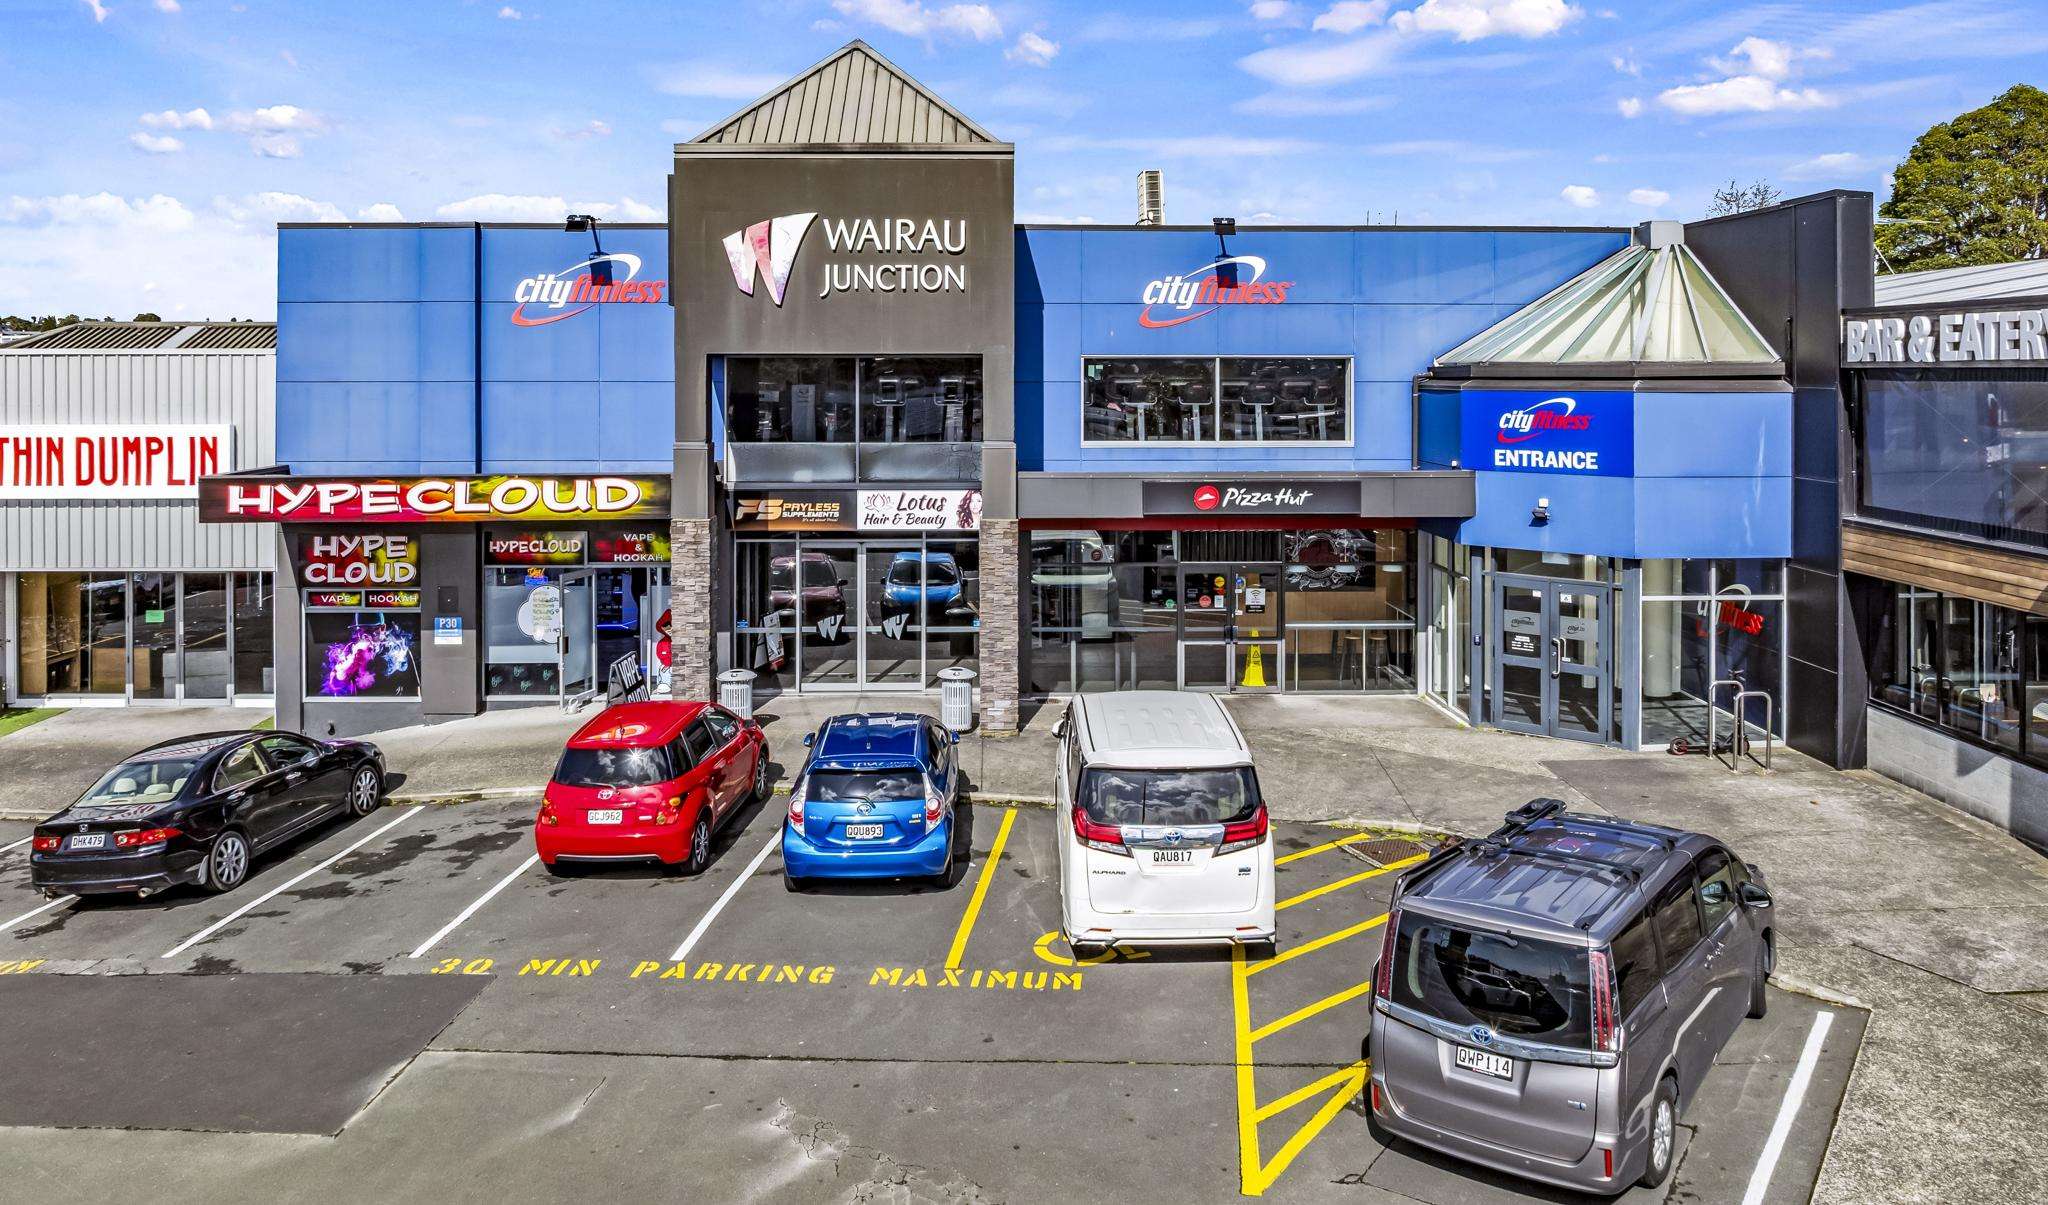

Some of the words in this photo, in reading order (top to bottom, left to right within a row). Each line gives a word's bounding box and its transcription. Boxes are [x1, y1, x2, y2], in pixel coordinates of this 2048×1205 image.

[823, 218, 966, 253] WAIRAU
[820, 264, 966, 298] JUNCTION
[1847, 317, 1906, 363] BAR
[1908, 315, 1935, 363] &
[1494, 449, 1598, 470] ENTRANCE
[227, 477, 642, 515] HYPECLOUD
[896, 492, 947, 512] Lotus
[1222, 487, 1273, 508] Pizza
[1273, 487, 1313, 506] Hut
[783, 503, 840, 511] PAYLESS
[864, 513, 889, 525] Hair
[892, 513, 902, 525] &
[906, 513, 947, 529] Beauty
[623, 533, 655, 541] VAPE
[313, 535, 409, 558] HYPE
[489, 539, 582, 554] HYPECLOUD
[634, 543, 643, 551] &
[614, 553, 663, 562] HOOKAH
[304, 562, 417, 583] CLOUD
[321, 595, 351, 603] VAPE
[369, 594, 417, 603] HOOKAH
[440, 618, 457, 628] P30
[847, 825, 882, 836] QQU893
[73, 835, 103, 847] DHK479
[1153, 851, 1192, 862] QAU817
[431, 958, 494, 975] 30
[518, 959, 601, 976] MIN
[630, 961, 836, 984] PARKING
[869, 967, 1084, 990] MAXIMUM
[1459, 1048, 1510, 1075] QWP114
